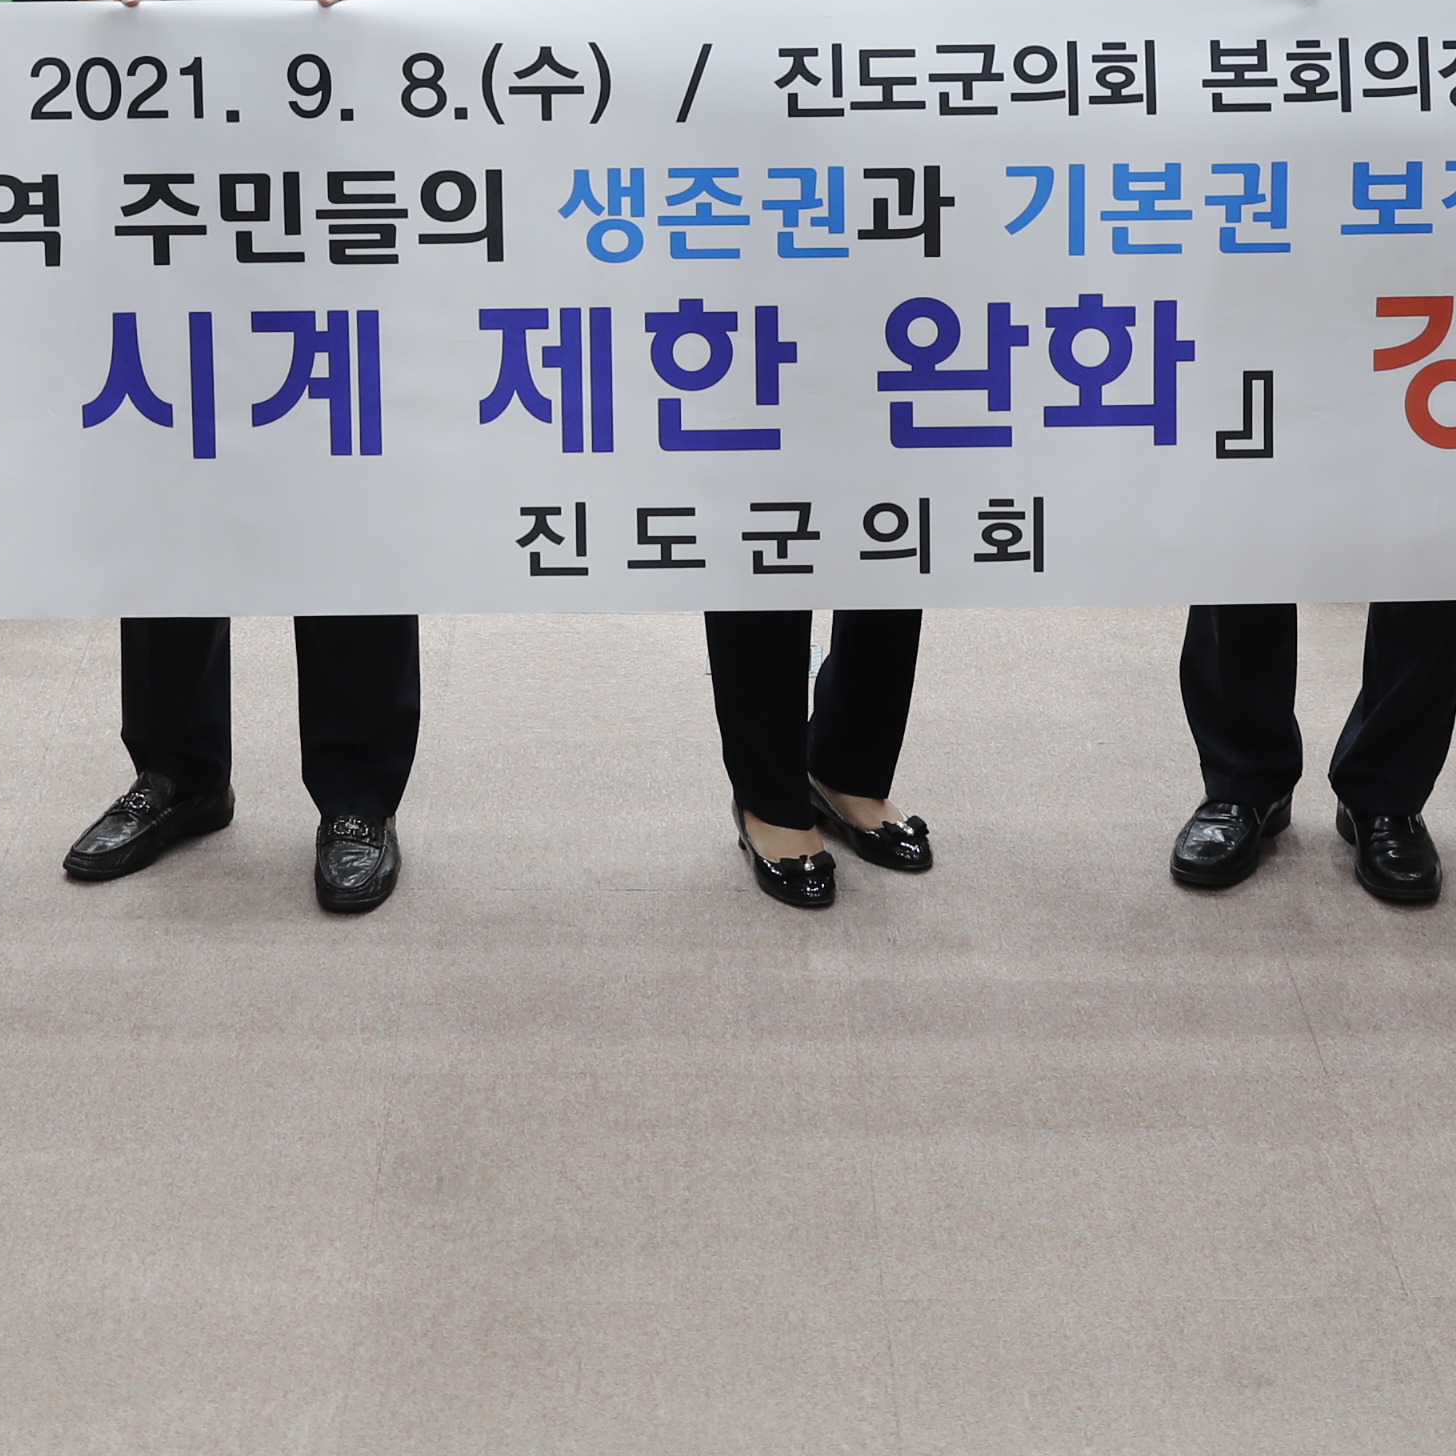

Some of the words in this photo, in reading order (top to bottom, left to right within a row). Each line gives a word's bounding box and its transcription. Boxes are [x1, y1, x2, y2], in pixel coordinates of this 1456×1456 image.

[31, 56, 239, 122] 2021.
[287, 54, 353, 121] 9.
[401, 43, 610, 124] 8.(수)
[676, 44, 712, 122] /
[775, 40, 1156, 117] 진도군의회
[115, 170, 503, 265] 주민들의
[559, 166, 955, 263] 생존권과
[1005, 162, 1291, 256] 기본권
[82, 310, 382, 459] 시계
[479, 299, 797, 453] 제한
